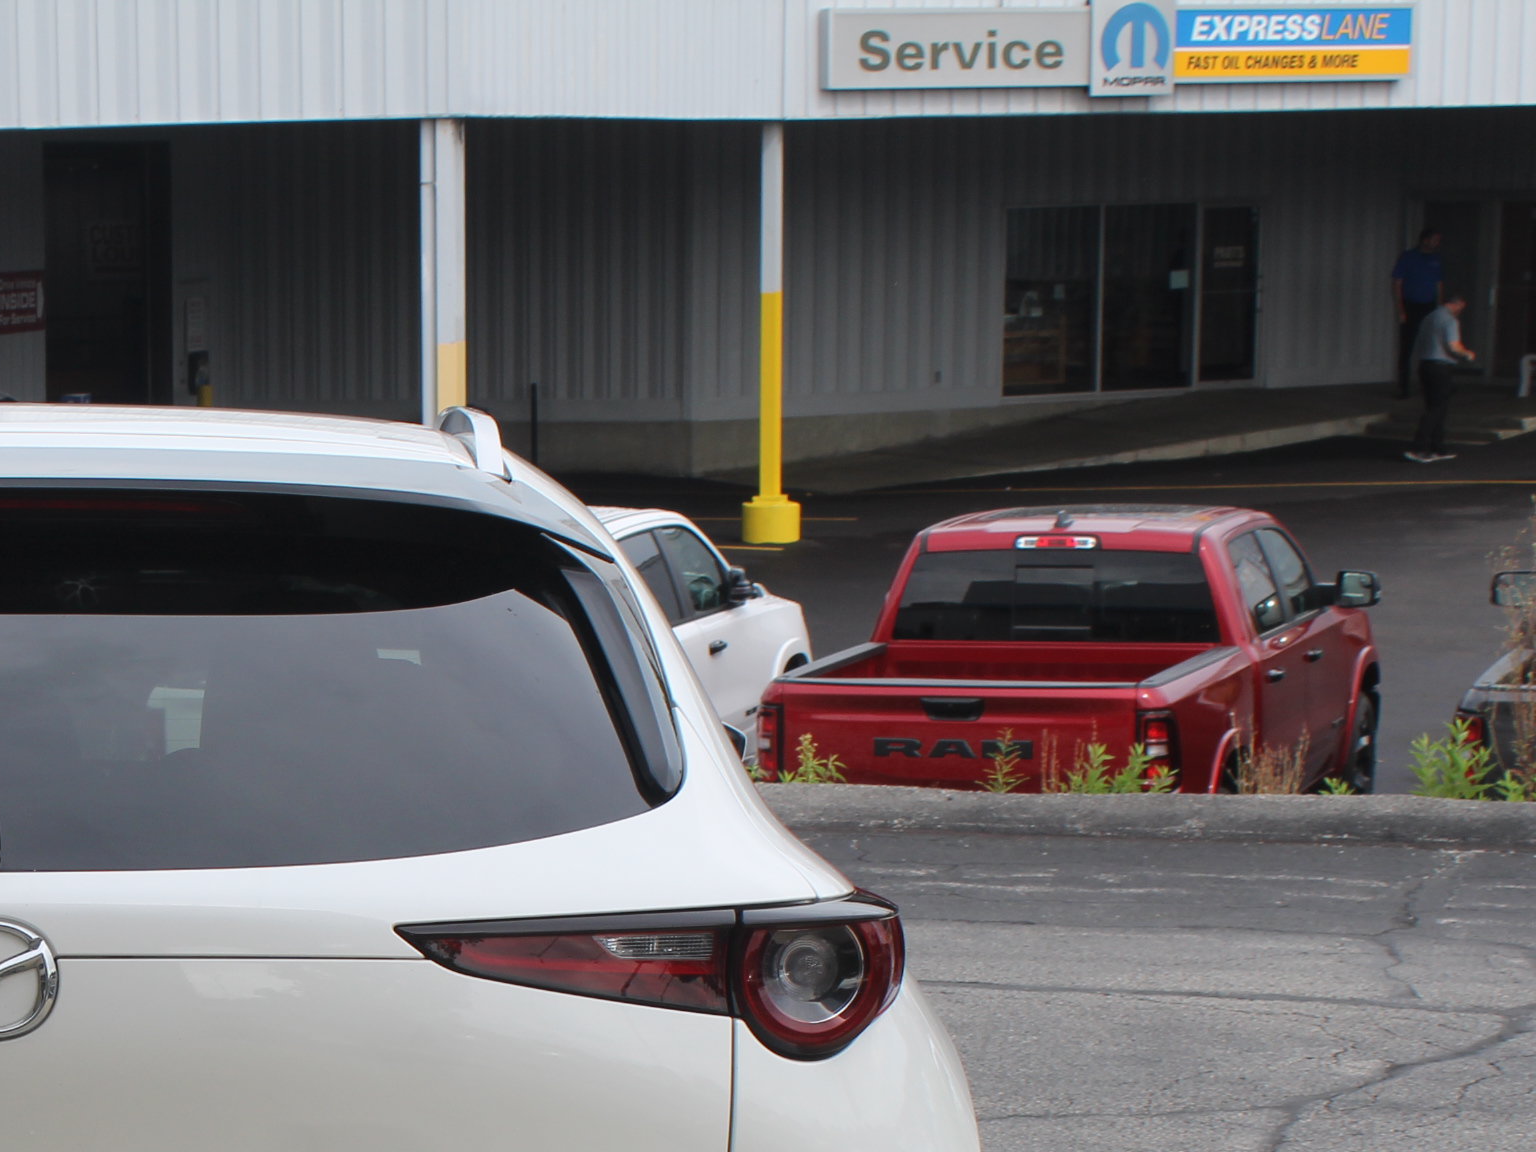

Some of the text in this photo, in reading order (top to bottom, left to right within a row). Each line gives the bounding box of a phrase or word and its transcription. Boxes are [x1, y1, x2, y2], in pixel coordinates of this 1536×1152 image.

[857, 29, 1065, 72] Service
[1186, 53, 1360, 70] FAST OIL CHANGES & MORE
[1101, 75, 1166, 87] MOPAR
[873, 737, 1034, 760] RAM
